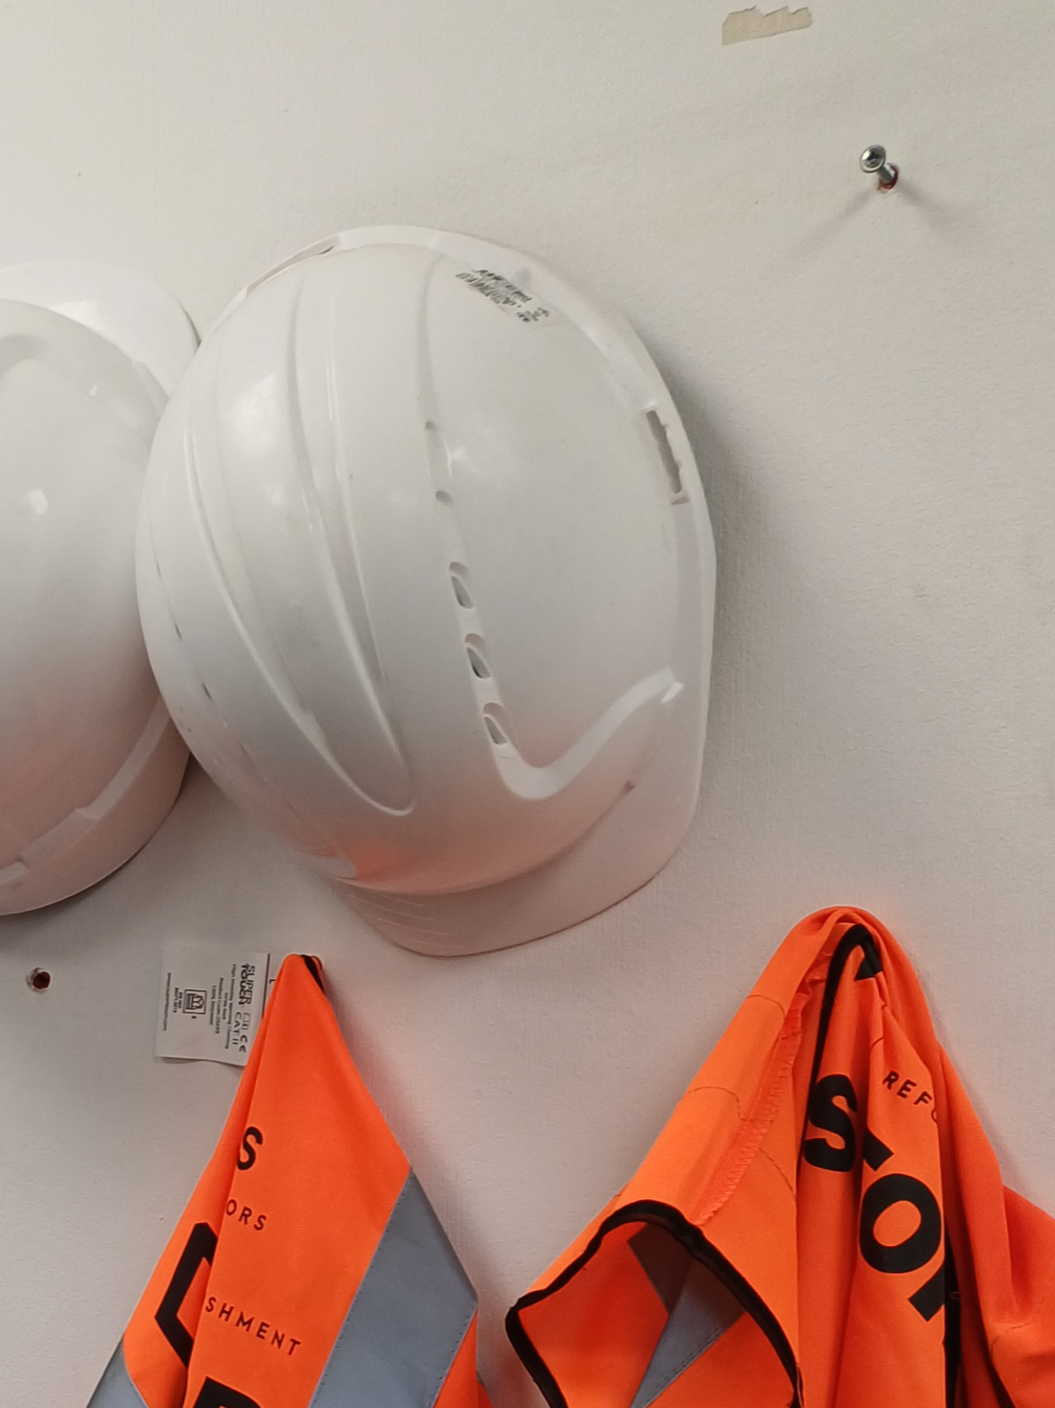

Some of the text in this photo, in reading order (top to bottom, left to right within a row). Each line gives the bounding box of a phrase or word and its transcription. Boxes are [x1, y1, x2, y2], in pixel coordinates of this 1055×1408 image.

[244, 965, 255, 1005] SUPER
[233, 1012, 242, 1035] CAT
[204, 1296, 302, 1357] SHMENT
